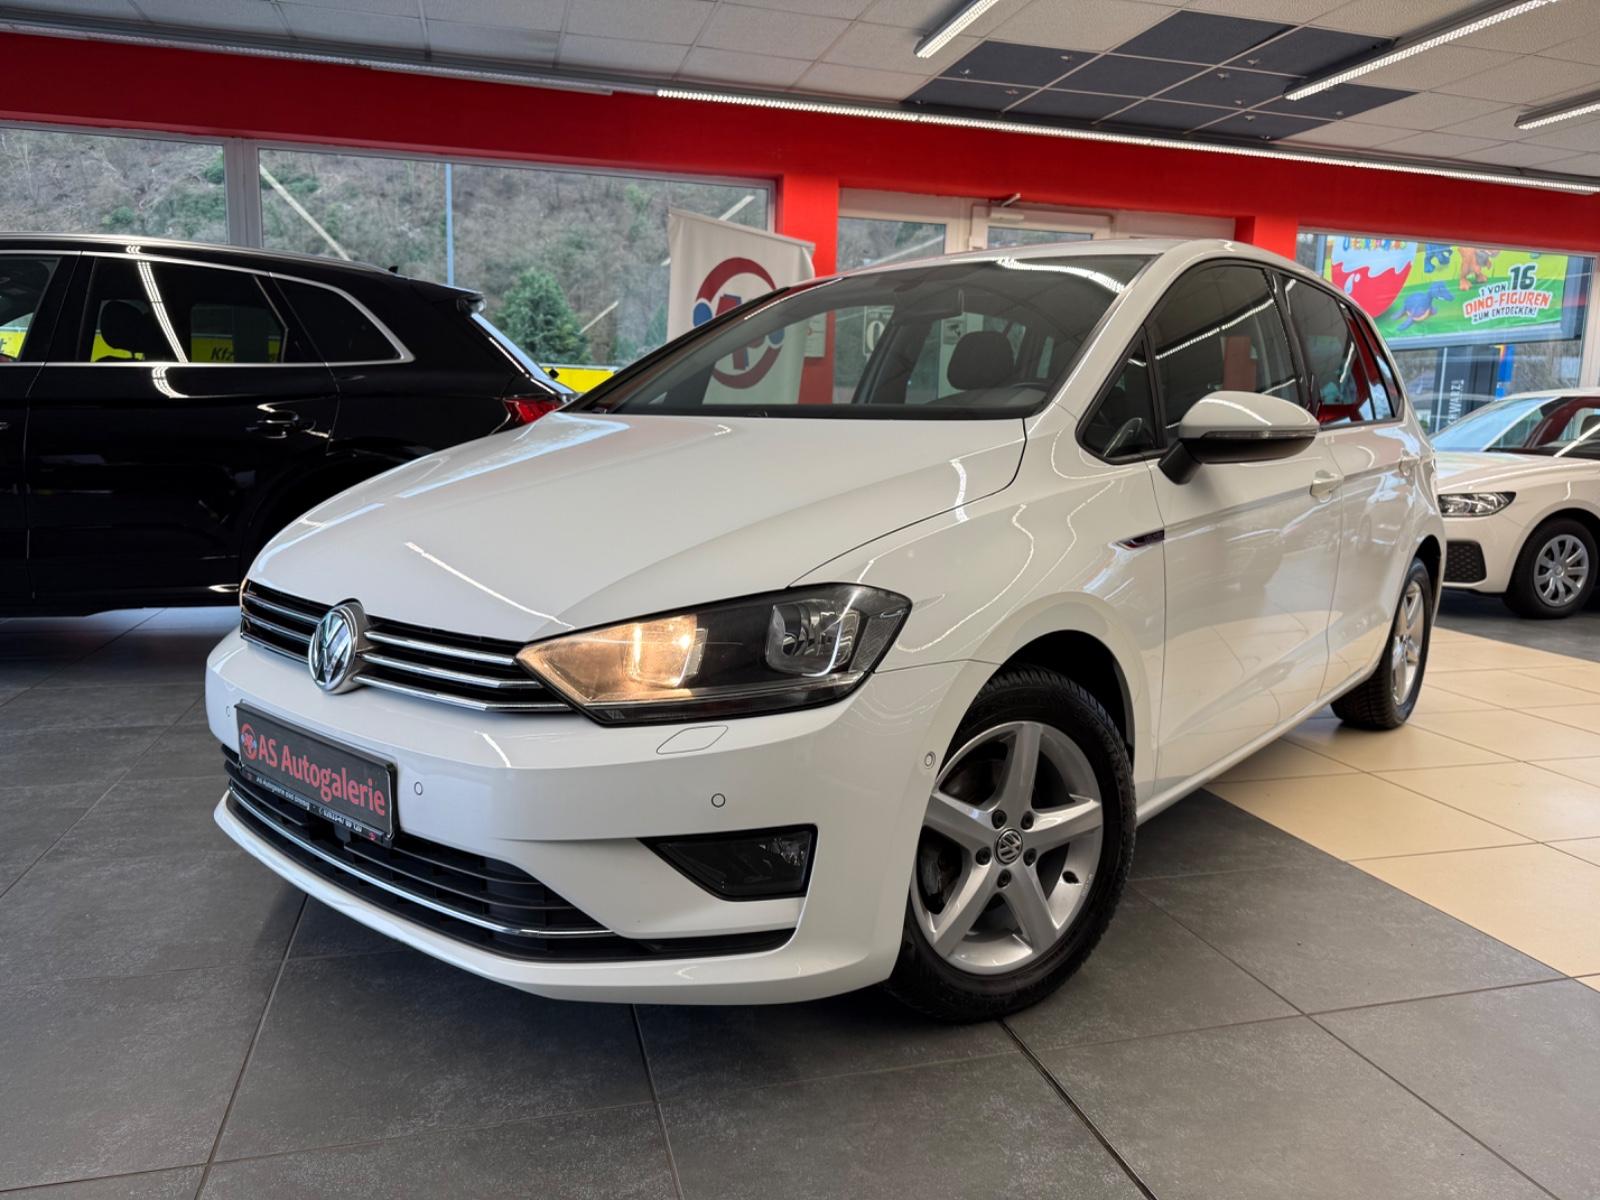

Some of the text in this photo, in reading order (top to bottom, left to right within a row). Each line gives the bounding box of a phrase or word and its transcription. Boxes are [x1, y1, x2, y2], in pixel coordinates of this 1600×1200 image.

[1488, 283, 1507, 294] VON
[1510, 265, 1536, 290] 16
[1464, 291, 1551, 316] DINO-FIGUREN
[1472, 306, 1537, 323] ZUM ENTDECKEN!
[258, 734, 278, 768] AS
[281, 745, 385, 816] Autogalerie
